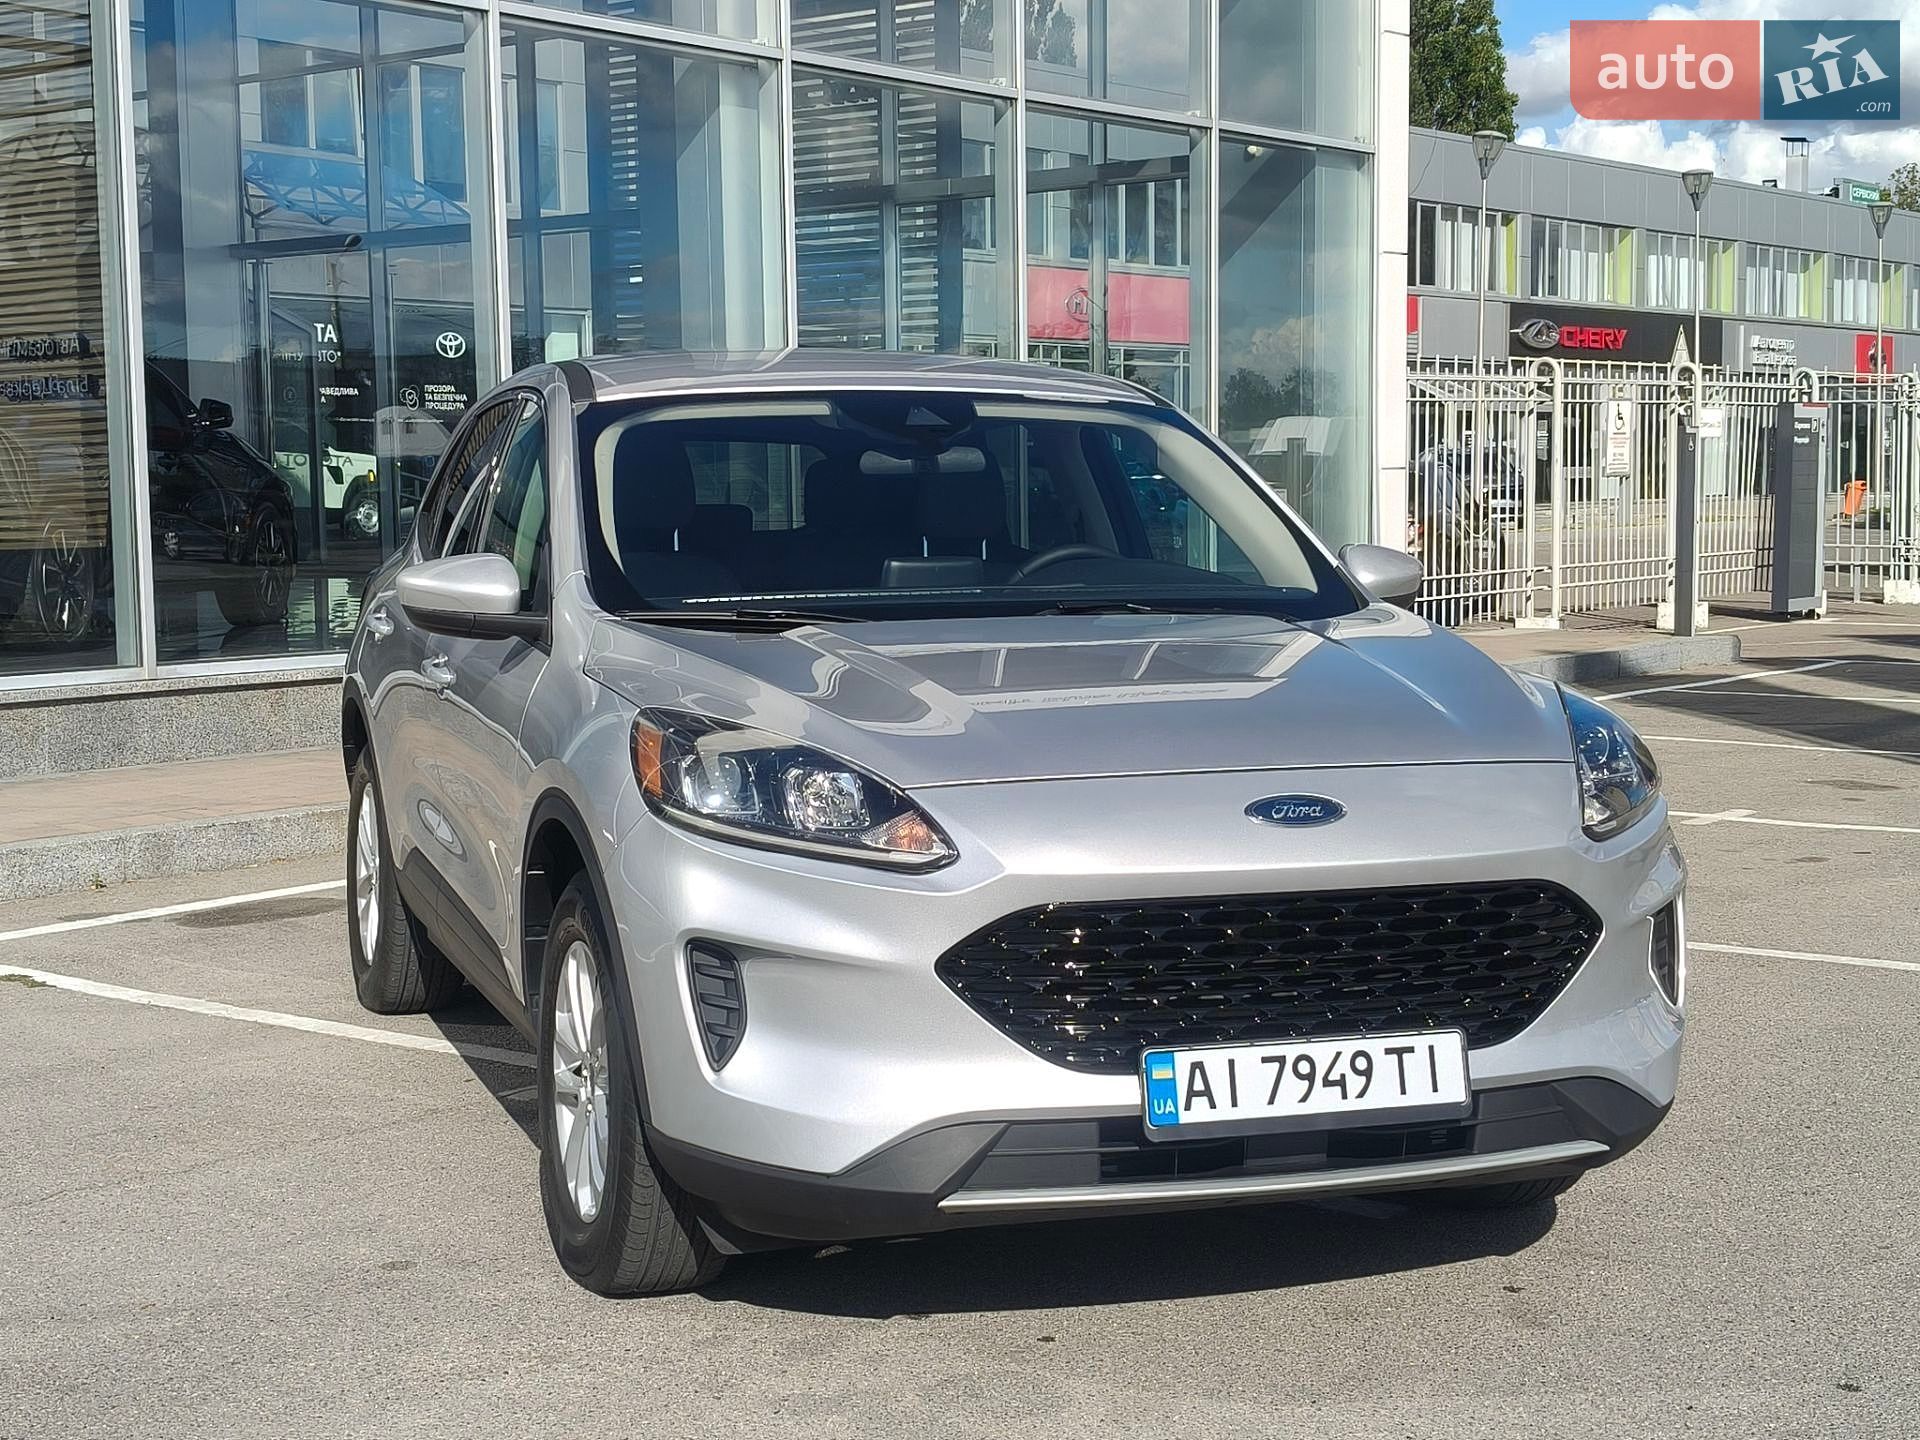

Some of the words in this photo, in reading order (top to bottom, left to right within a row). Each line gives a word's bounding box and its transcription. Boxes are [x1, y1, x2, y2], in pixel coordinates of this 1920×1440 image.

[1560, 325, 1628, 350] CHERY
[424, 384, 456, 393] ПРОЗОРА
[425, 402, 465, 411] ПРОЦЕДУРА
[1271, 801, 1324, 819] Ford
[1183, 1058, 1239, 1112] AI
[1260, 1049, 1374, 1106] 7949
[1384, 1044, 1439, 1096] TI
[1153, 1098, 1176, 1115] UA
